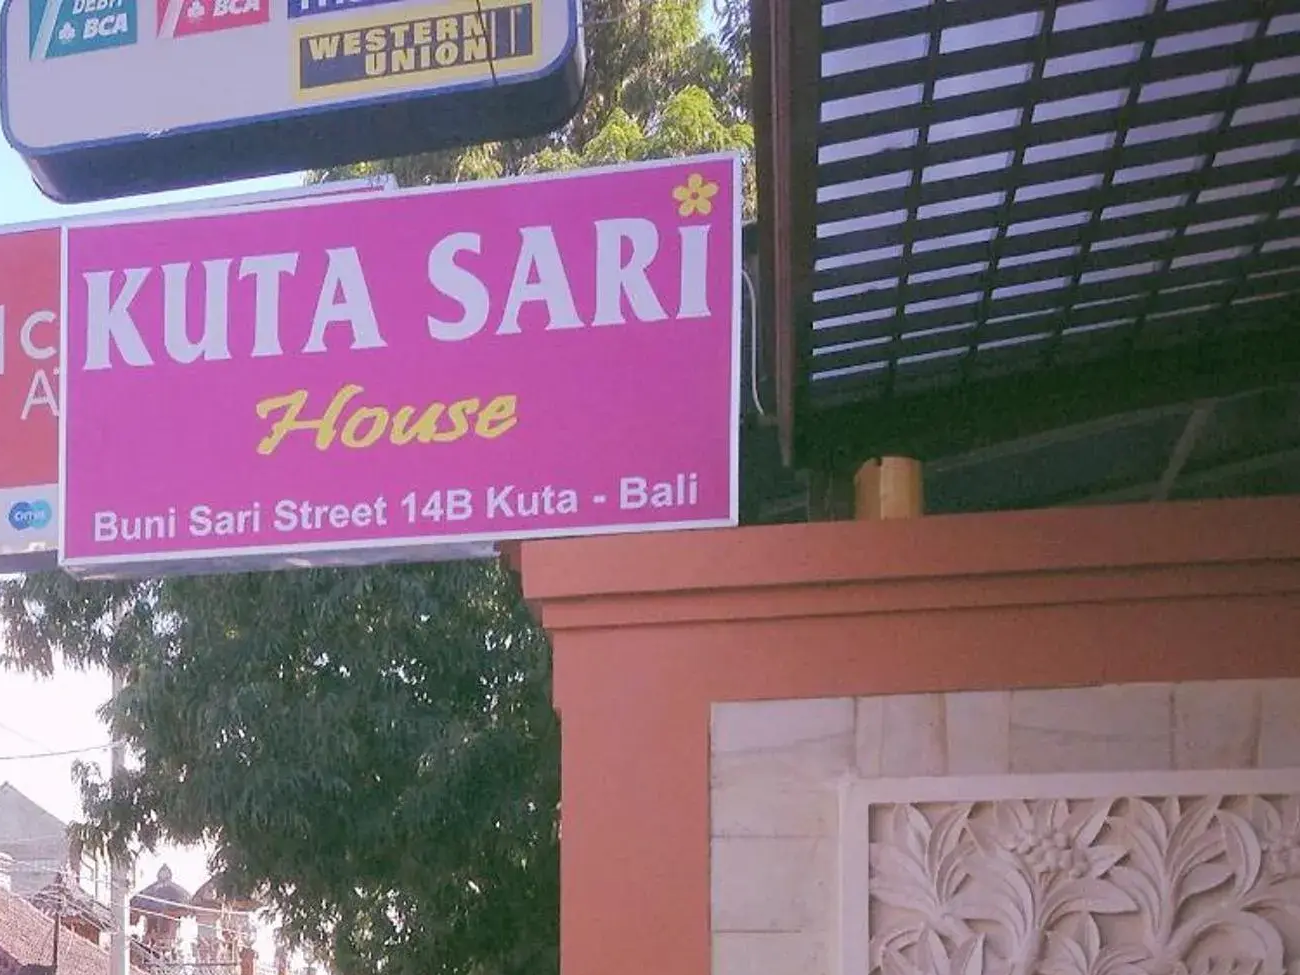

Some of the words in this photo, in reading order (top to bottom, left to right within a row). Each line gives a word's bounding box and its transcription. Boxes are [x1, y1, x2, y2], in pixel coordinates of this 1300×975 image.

[83, 13, 128, 39] BCA
[213, 0, 260, 16] BCA
[309, 13, 487, 61] WESTERN
[365, 37, 487, 76] UNION
[81, 245, 388, 371] KUTA
[20, 368, 59, 420] A
[256, 383, 518, 456] House
[93, 511, 176, 542] Buni
[189, 505, 261, 538] Sari
[274, 495, 388, 532] Street
[401, 488, 473, 523] 14B
[485, 484, 578, 519] Kuta
[619, 472, 699, 510] Bali
